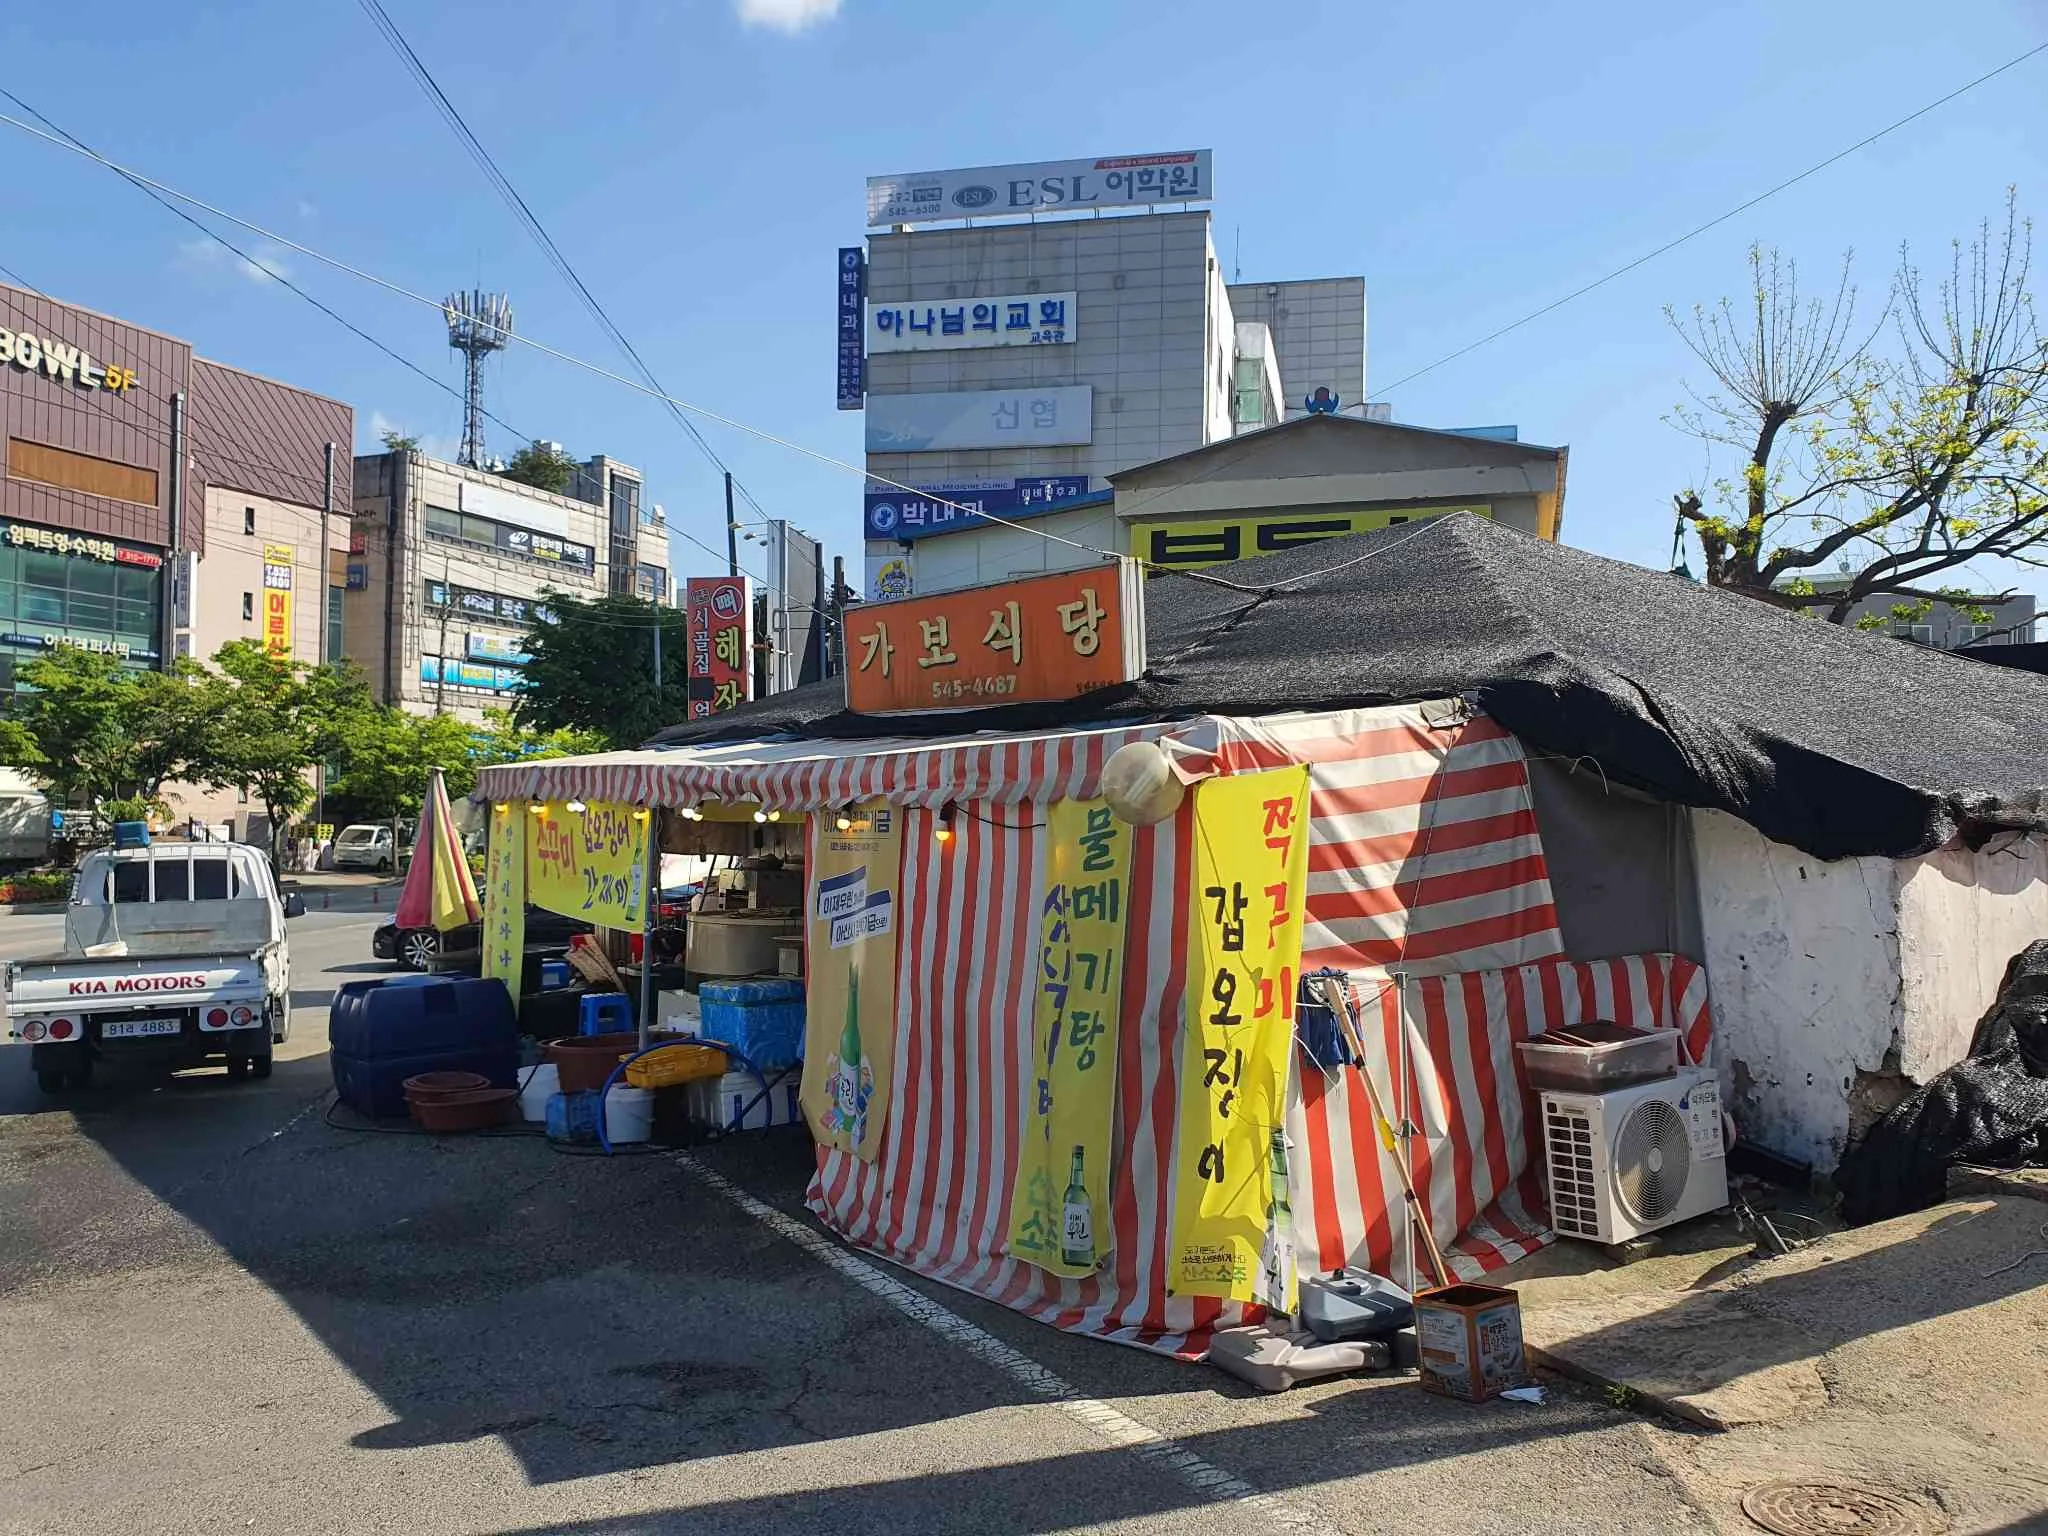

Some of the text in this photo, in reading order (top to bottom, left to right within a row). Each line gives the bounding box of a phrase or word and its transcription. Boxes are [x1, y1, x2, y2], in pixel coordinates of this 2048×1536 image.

[1007, 165, 1198, 206] ESL 어학원
[991, 399, 1057, 430] 신협
[693, 608, 710, 674] 시골집
[859, 589, 1107, 678] 가보식당
[931, 674, 1017, 698] 545-4687
[1069, 807, 1120, 1072] 물메기탕
[69, 975, 206, 995] KIA MOTORS
[1197, 881, 1249, 1186] 갑오징어
